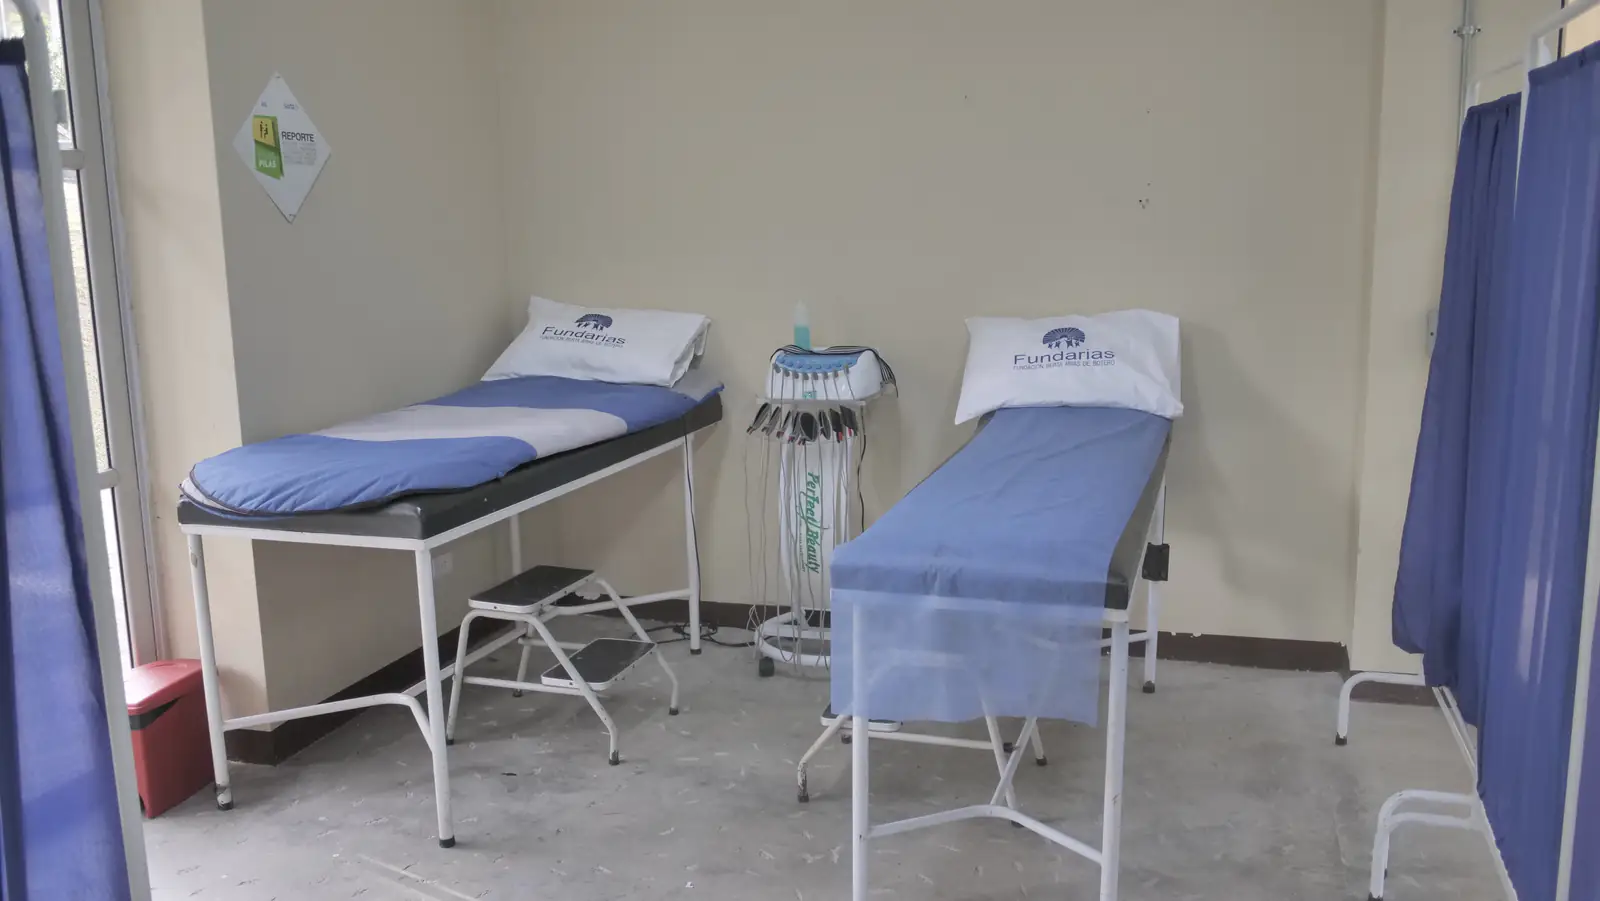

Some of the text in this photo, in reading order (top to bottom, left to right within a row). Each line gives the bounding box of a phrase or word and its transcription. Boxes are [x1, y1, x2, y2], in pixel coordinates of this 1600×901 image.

[281, 131, 315, 142] REPORTE
[259, 159, 277, 168] PILAS
[542, 326, 626, 345] Fundarias
[1014, 349, 1115, 364] Fundarias
